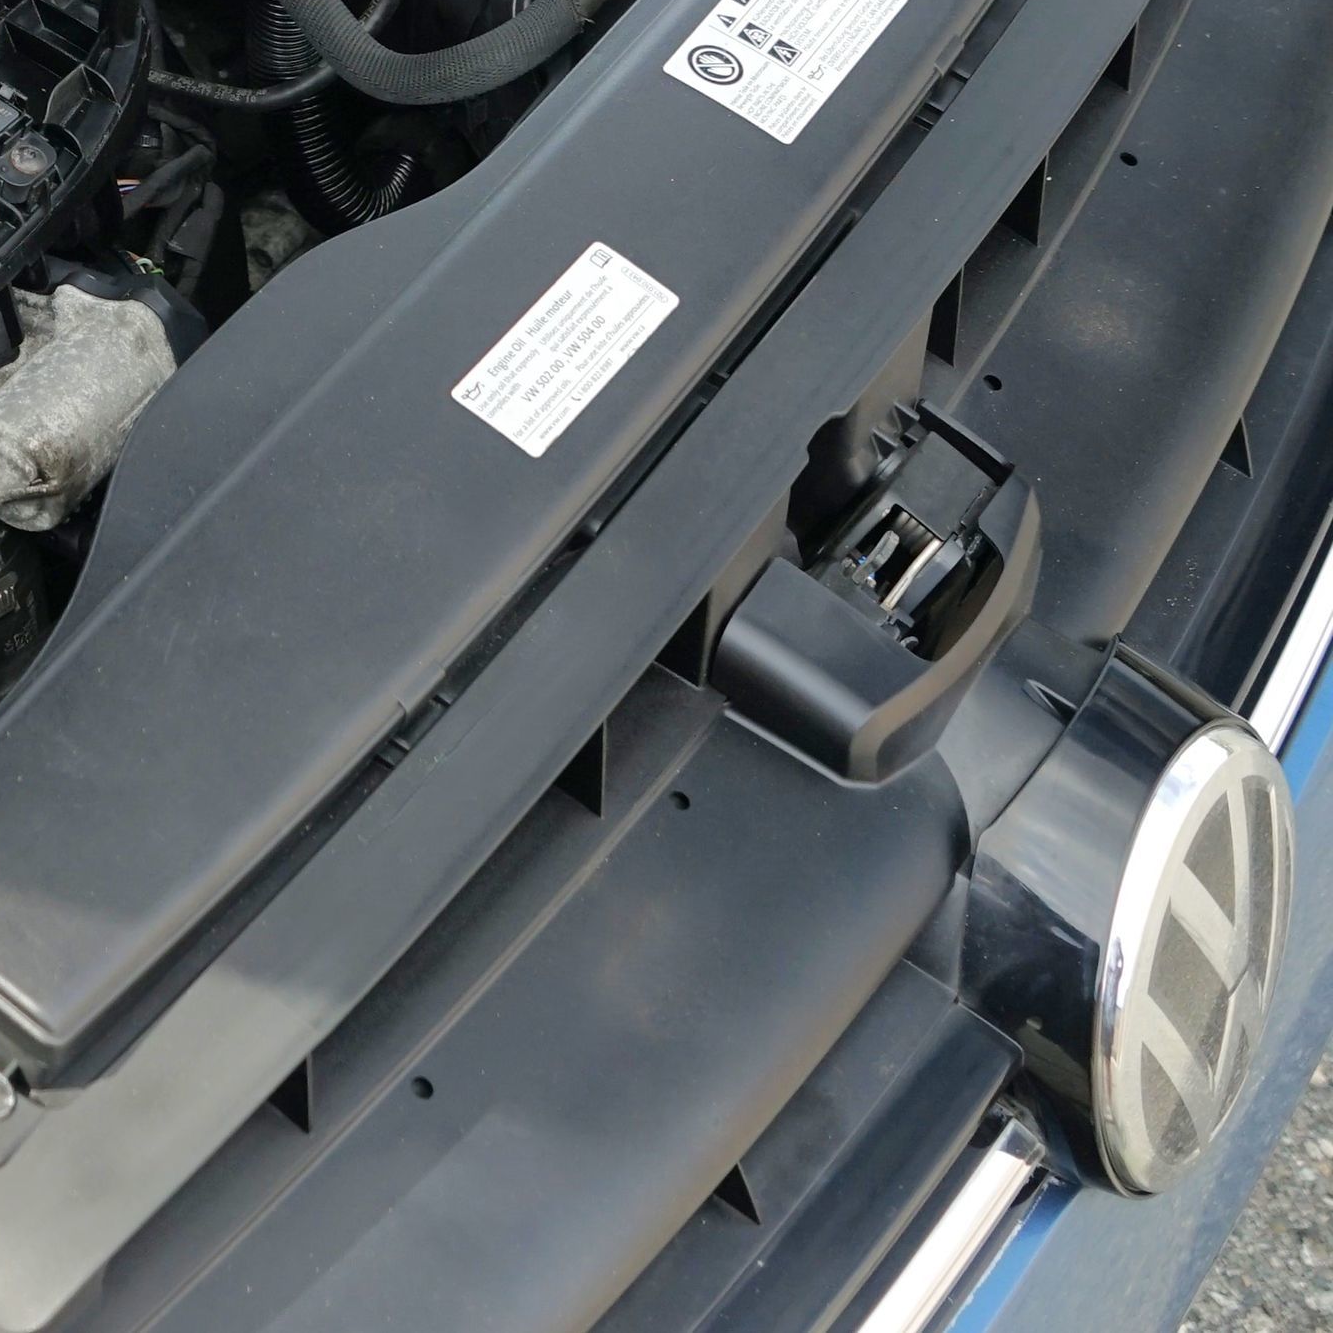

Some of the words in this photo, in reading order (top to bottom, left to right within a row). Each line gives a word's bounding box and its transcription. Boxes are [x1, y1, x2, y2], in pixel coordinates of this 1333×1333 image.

[524, 313, 549, 337] Huile
[543, 289, 574, 318] moteur
[475, 399, 490, 412] Use
[485, 388, 502, 403] only
[496, 381, 507, 391] oil
[502, 369, 517, 383] that
[513, 347, 541, 374] expressly
[485, 348, 519, 379] Engine
[510, 337, 526, 352] Oil
[520, 384, 541, 403] VW
[534, 369, 555, 389] 502
[562, 340, 582, 359] VW
[576, 325, 596, 344] 504
[589, 314, 607, 329] 00
[485, 393, 512, 420] complies
[506, 381, 522, 396] with
[523, 415, 536, 427] list
[531, 409, 542, 418] of
